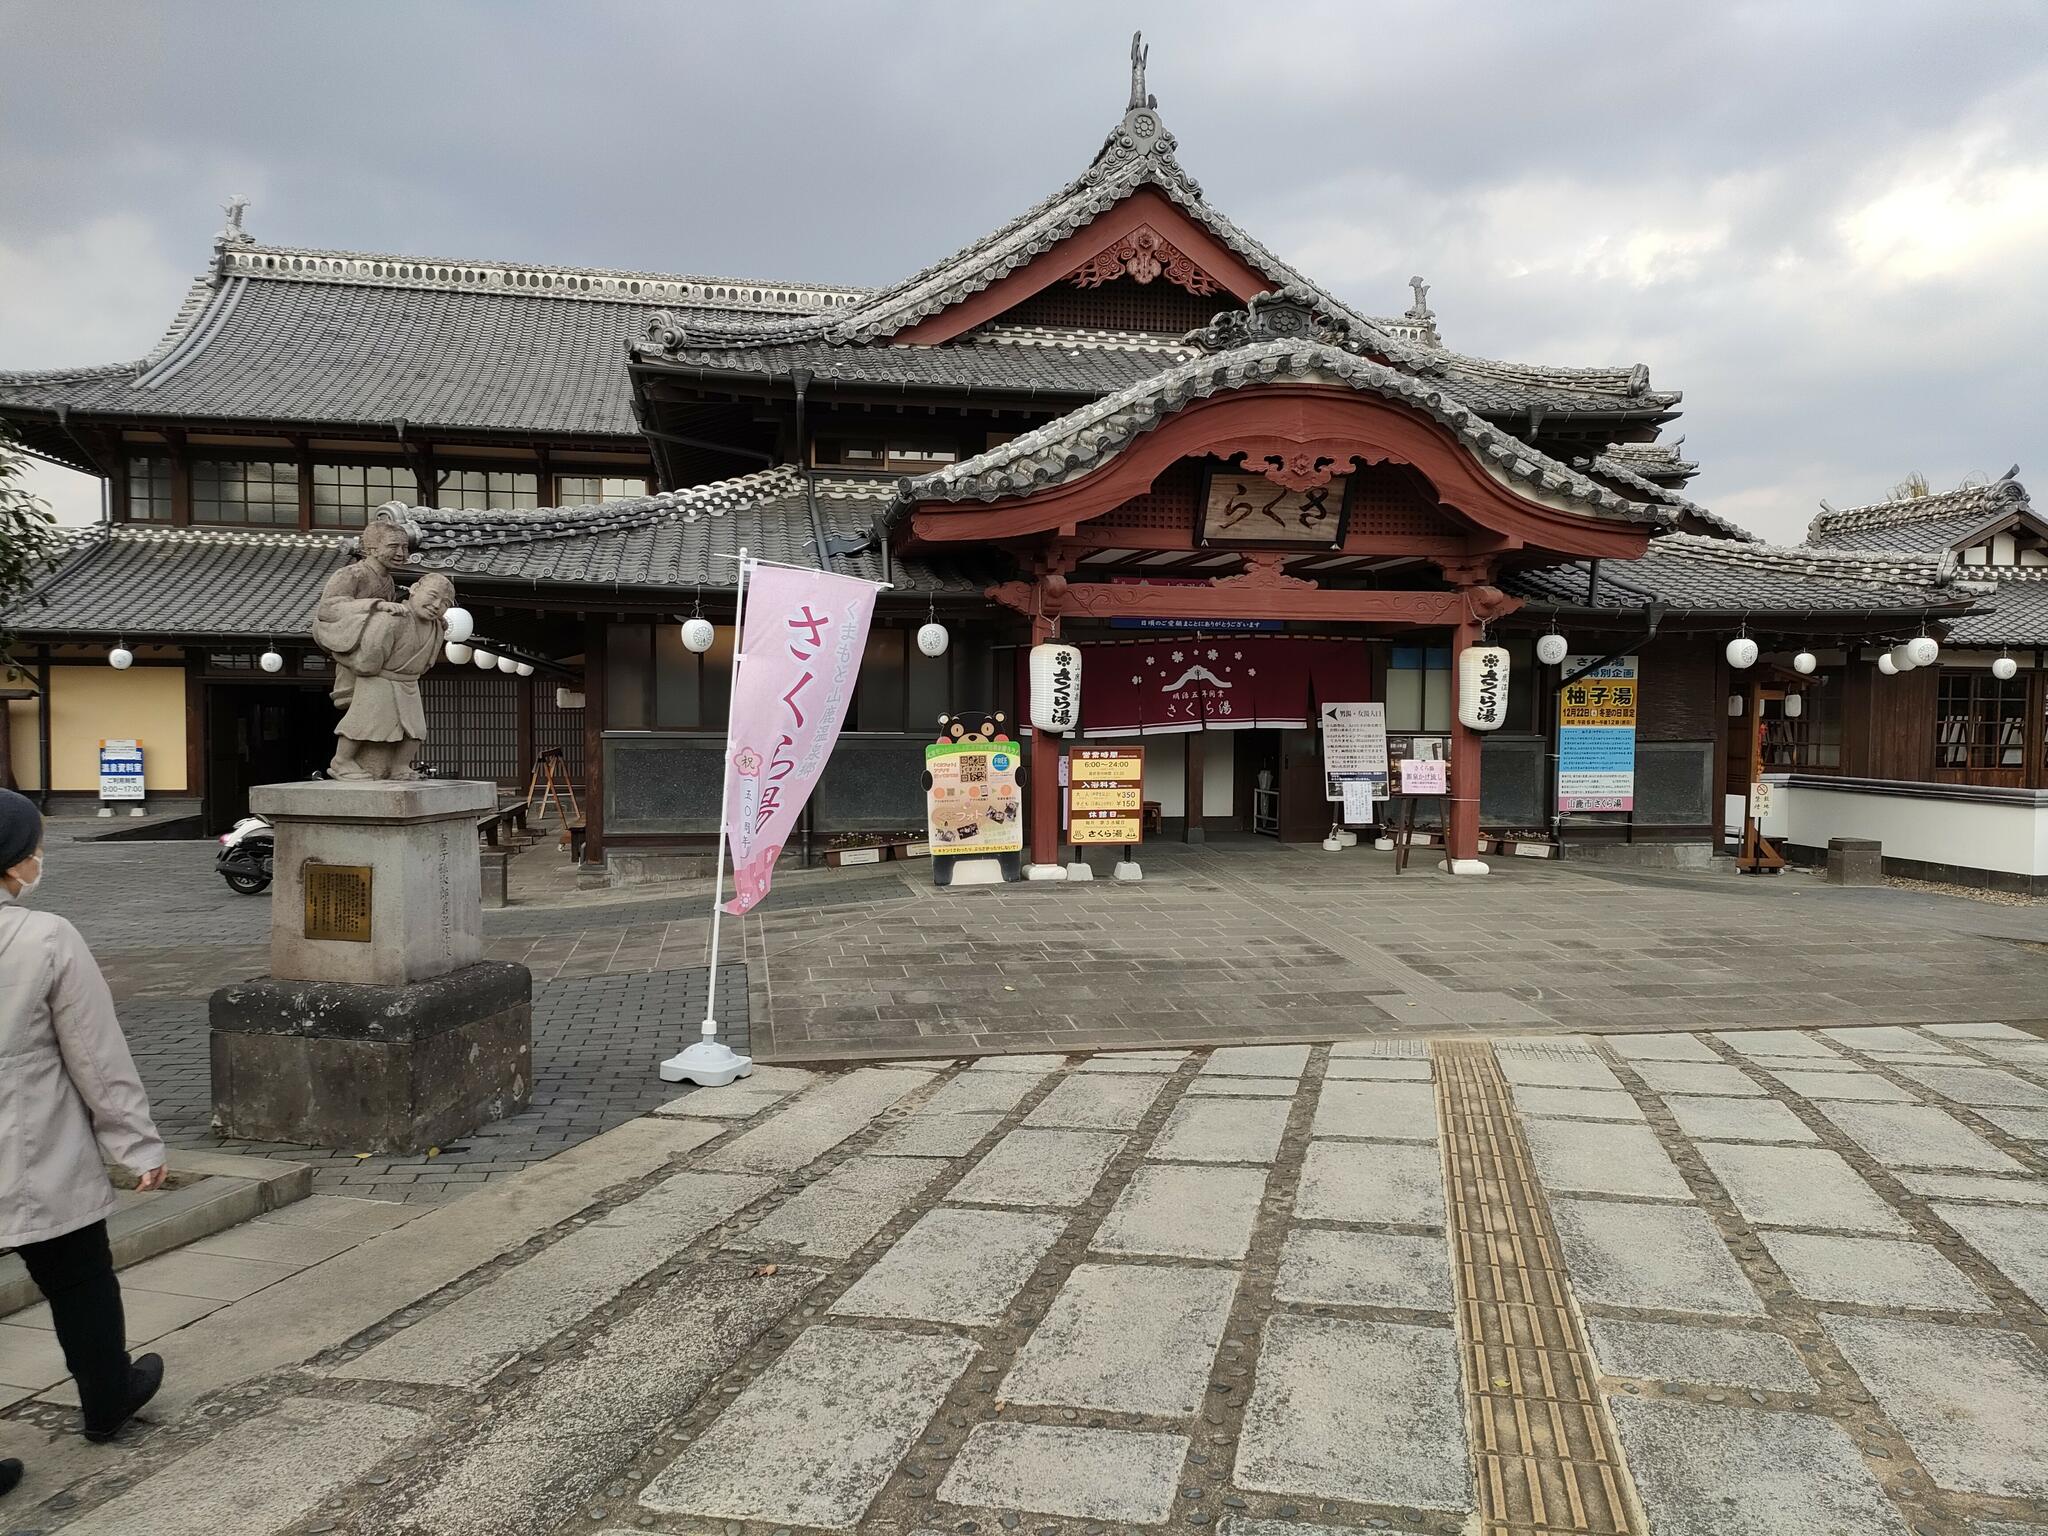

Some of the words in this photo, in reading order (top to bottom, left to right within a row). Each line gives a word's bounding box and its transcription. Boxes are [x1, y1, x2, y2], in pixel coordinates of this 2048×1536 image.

[1051, 668, 1072, 725] さくら湯
[1477, 670, 1498, 722] さくら湯
[1567, 687, 1632, 705] 柚子湯
[1166, 701, 1232, 717] さくら湯
[741, 756, 755, 769] 祝
[1568, 799, 1592, 809] 山鹿市
[1594, 799, 1622, 808] さくら湯
[1088, 830, 1122, 838] さくら湯
